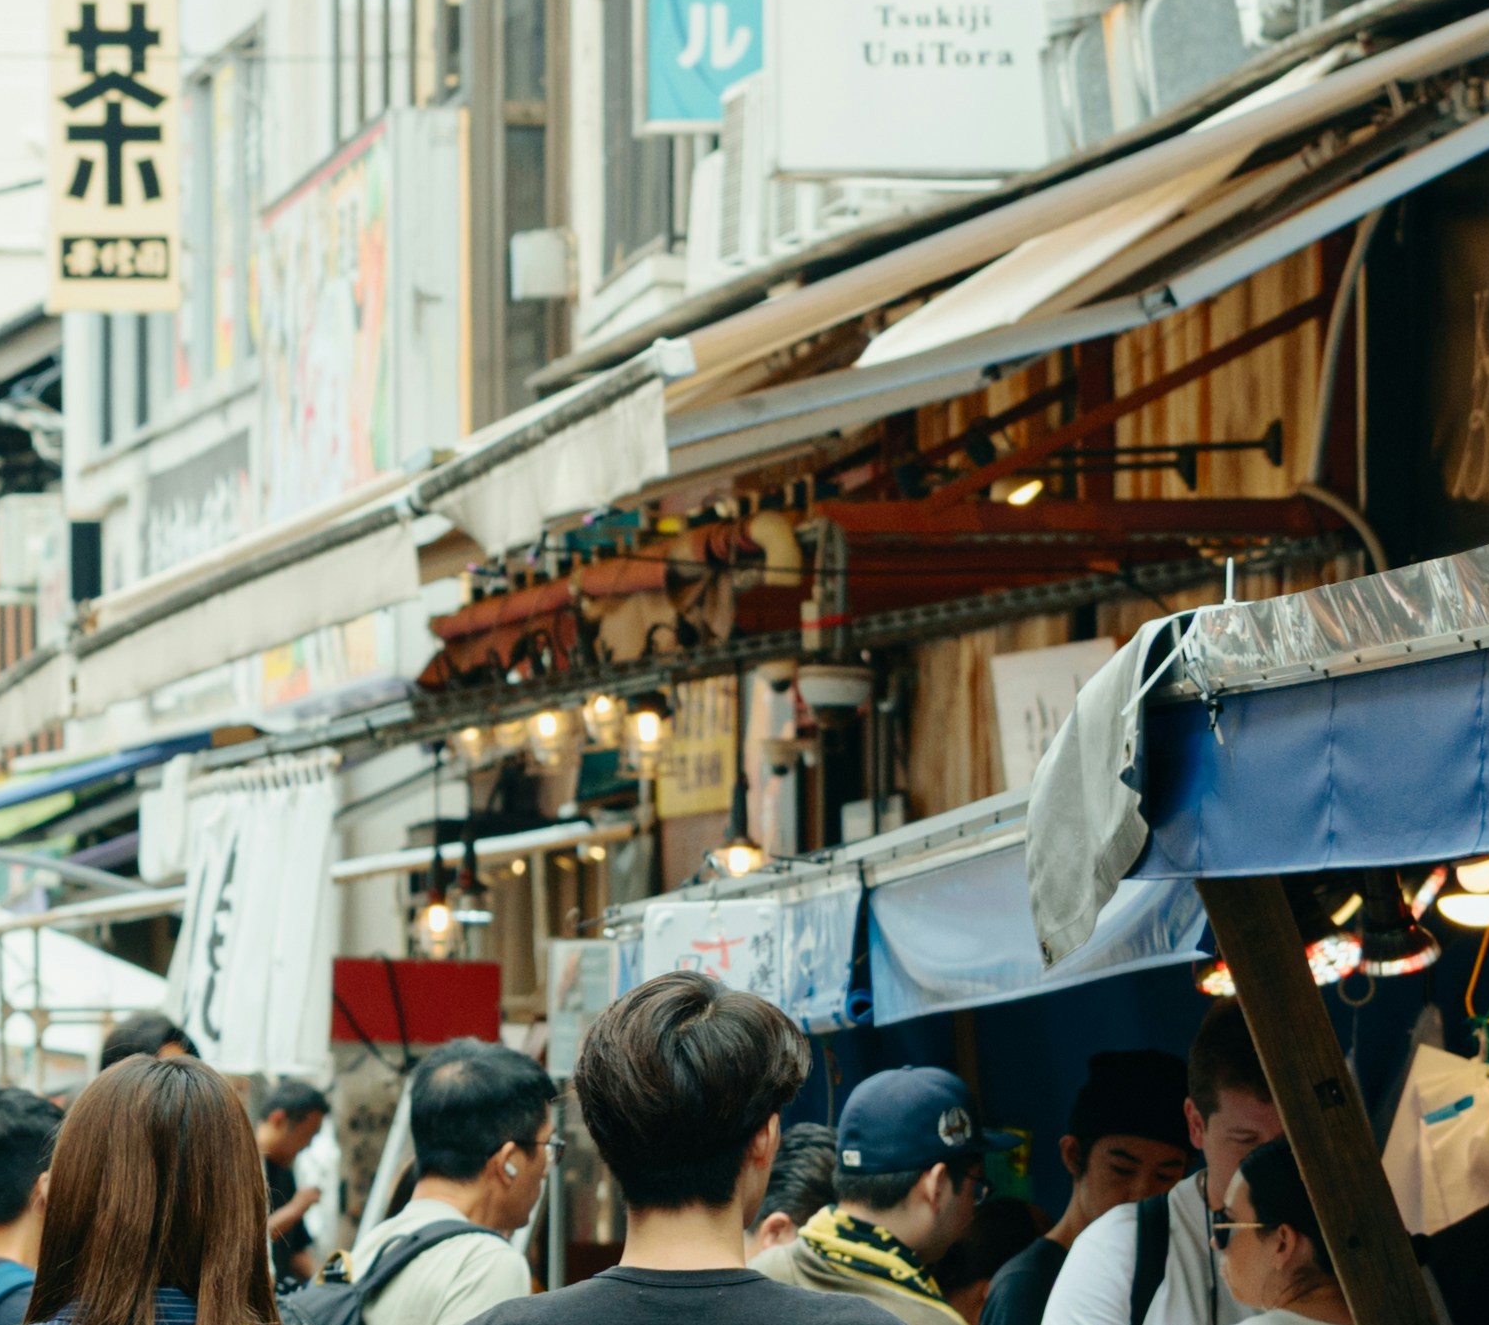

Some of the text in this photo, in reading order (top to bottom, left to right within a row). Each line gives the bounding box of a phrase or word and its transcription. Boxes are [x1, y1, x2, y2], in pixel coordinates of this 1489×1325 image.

[876, 5, 994, 34] Tsukiji
[862, 42, 1015, 68] UniTora
[61, 2, 167, 206] 茶
